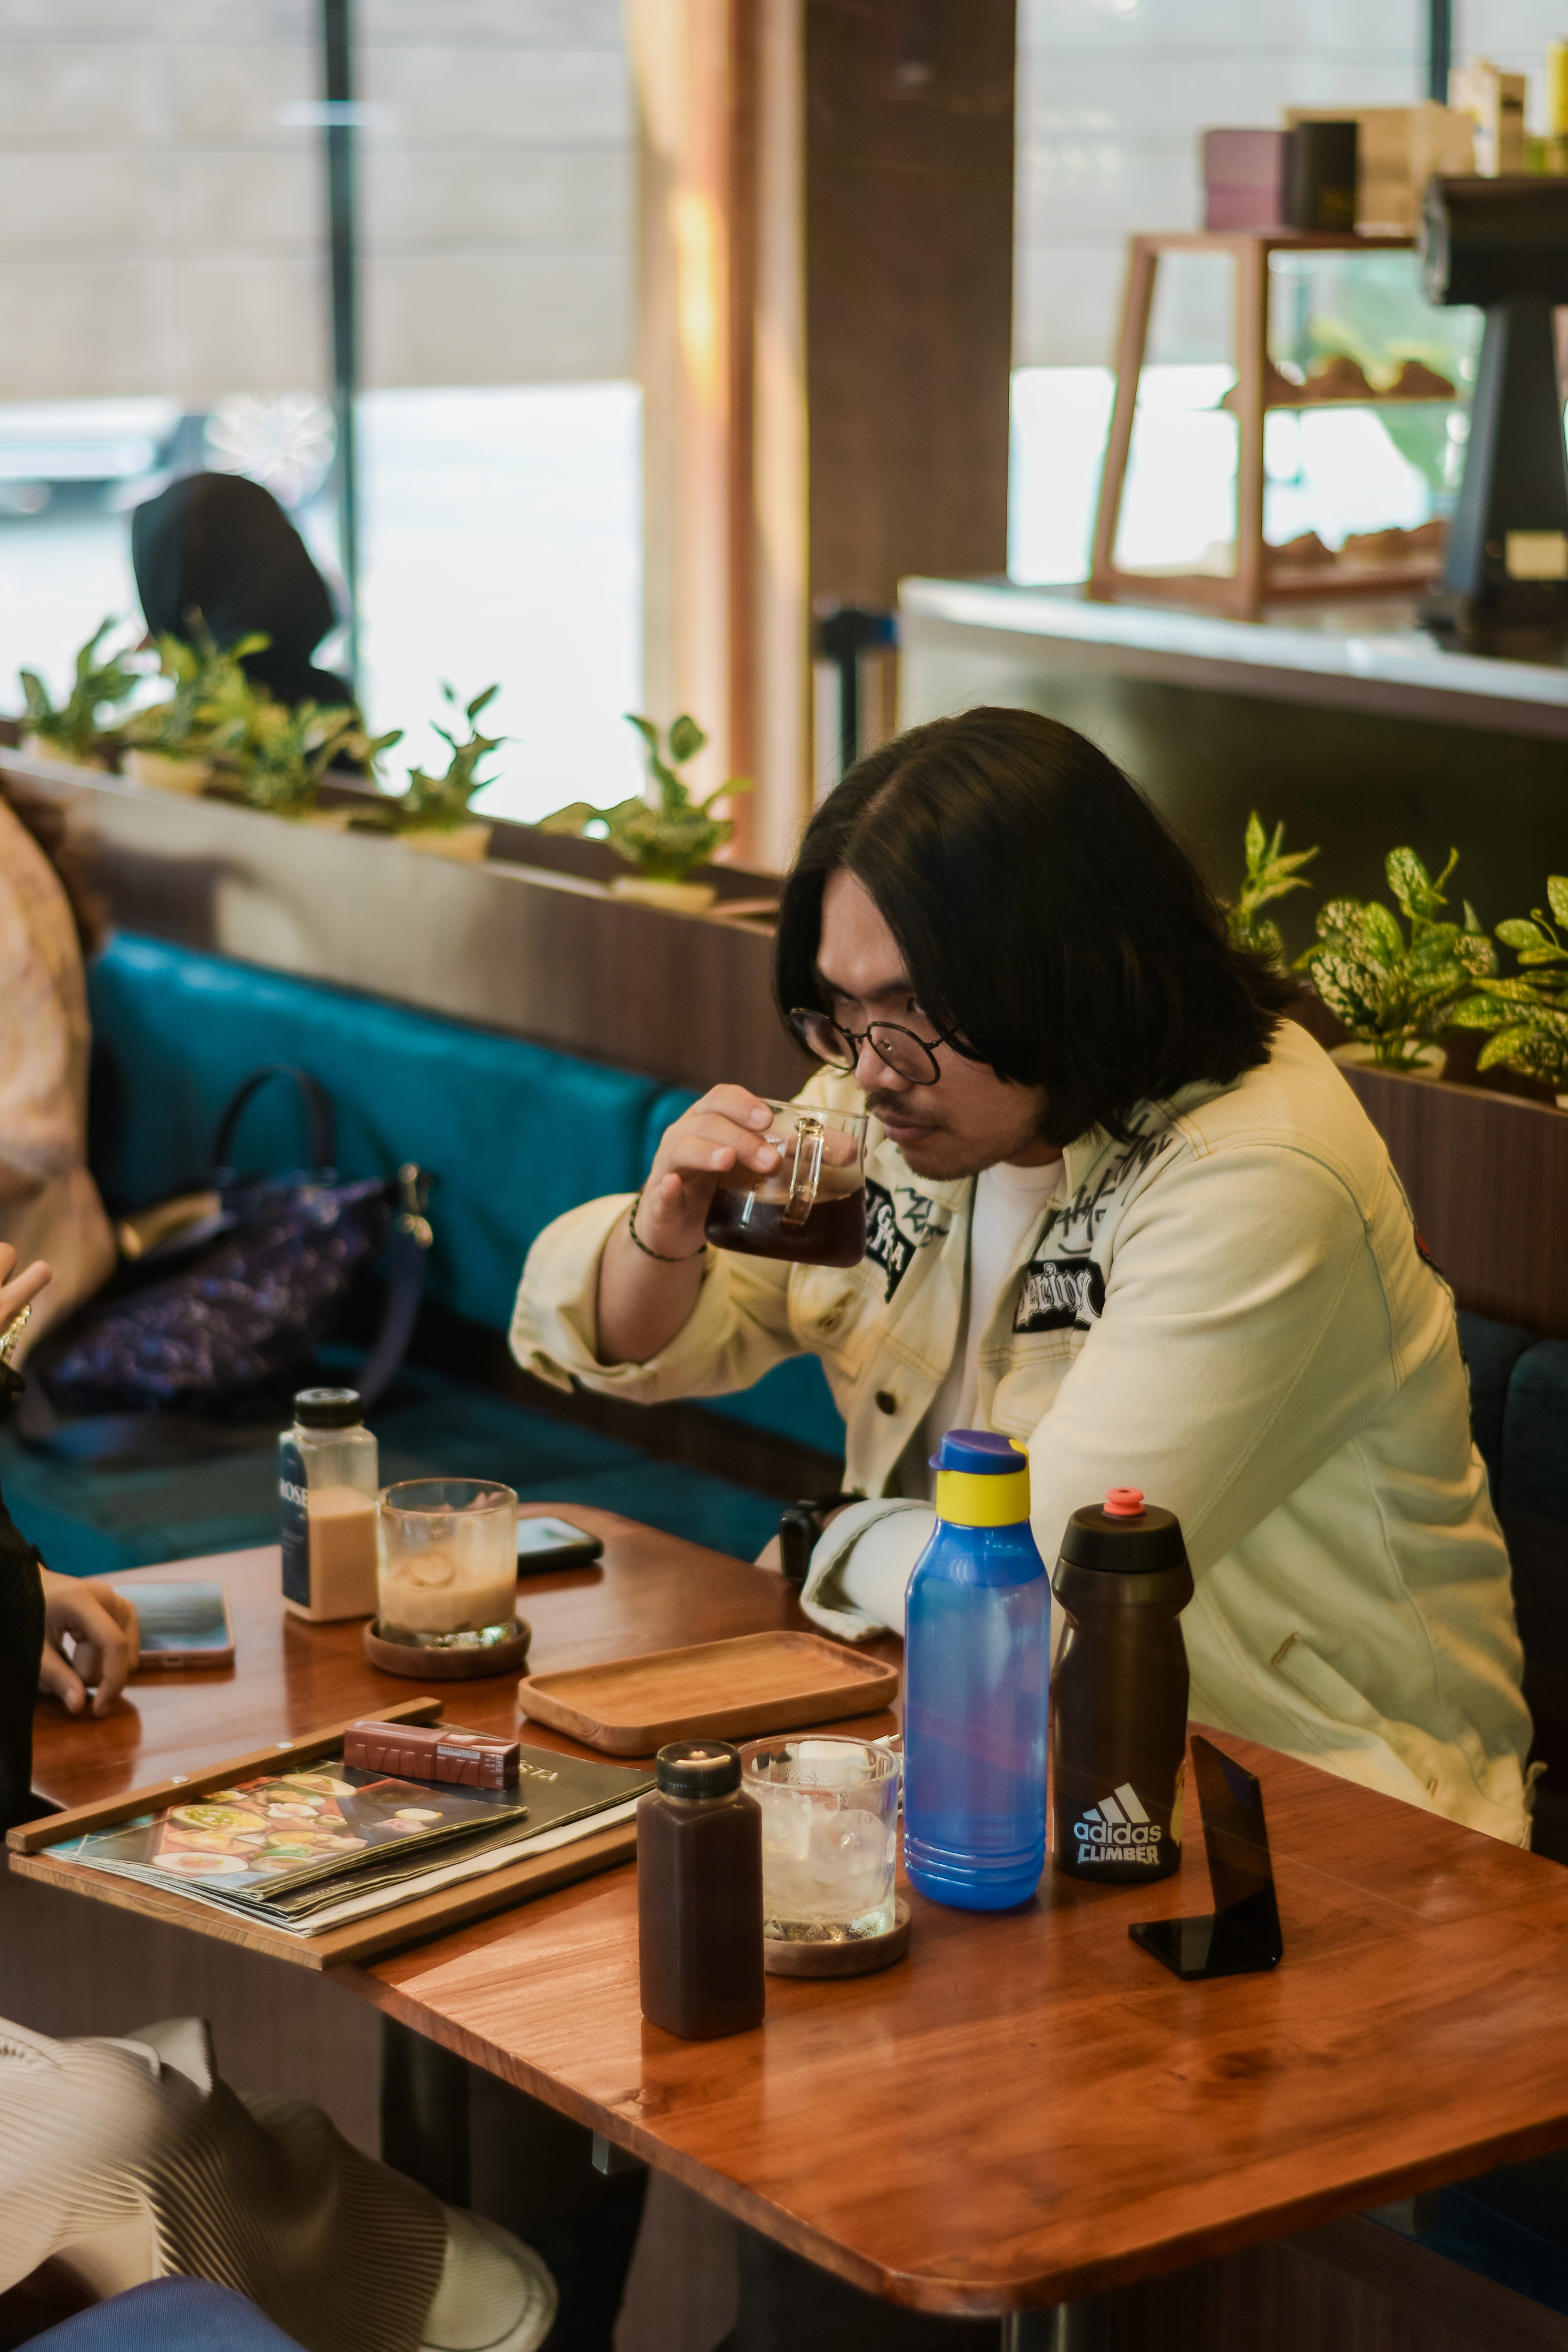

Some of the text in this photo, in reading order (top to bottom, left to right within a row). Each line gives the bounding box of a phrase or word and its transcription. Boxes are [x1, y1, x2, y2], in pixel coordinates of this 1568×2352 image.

[440, 1746, 477, 1755] MAYBELLINE
[520, 1760, 558, 1780] STA
[1074, 1821, 1161, 1844] adidas
[1077, 1843, 1161, 1865] CLIMBER
